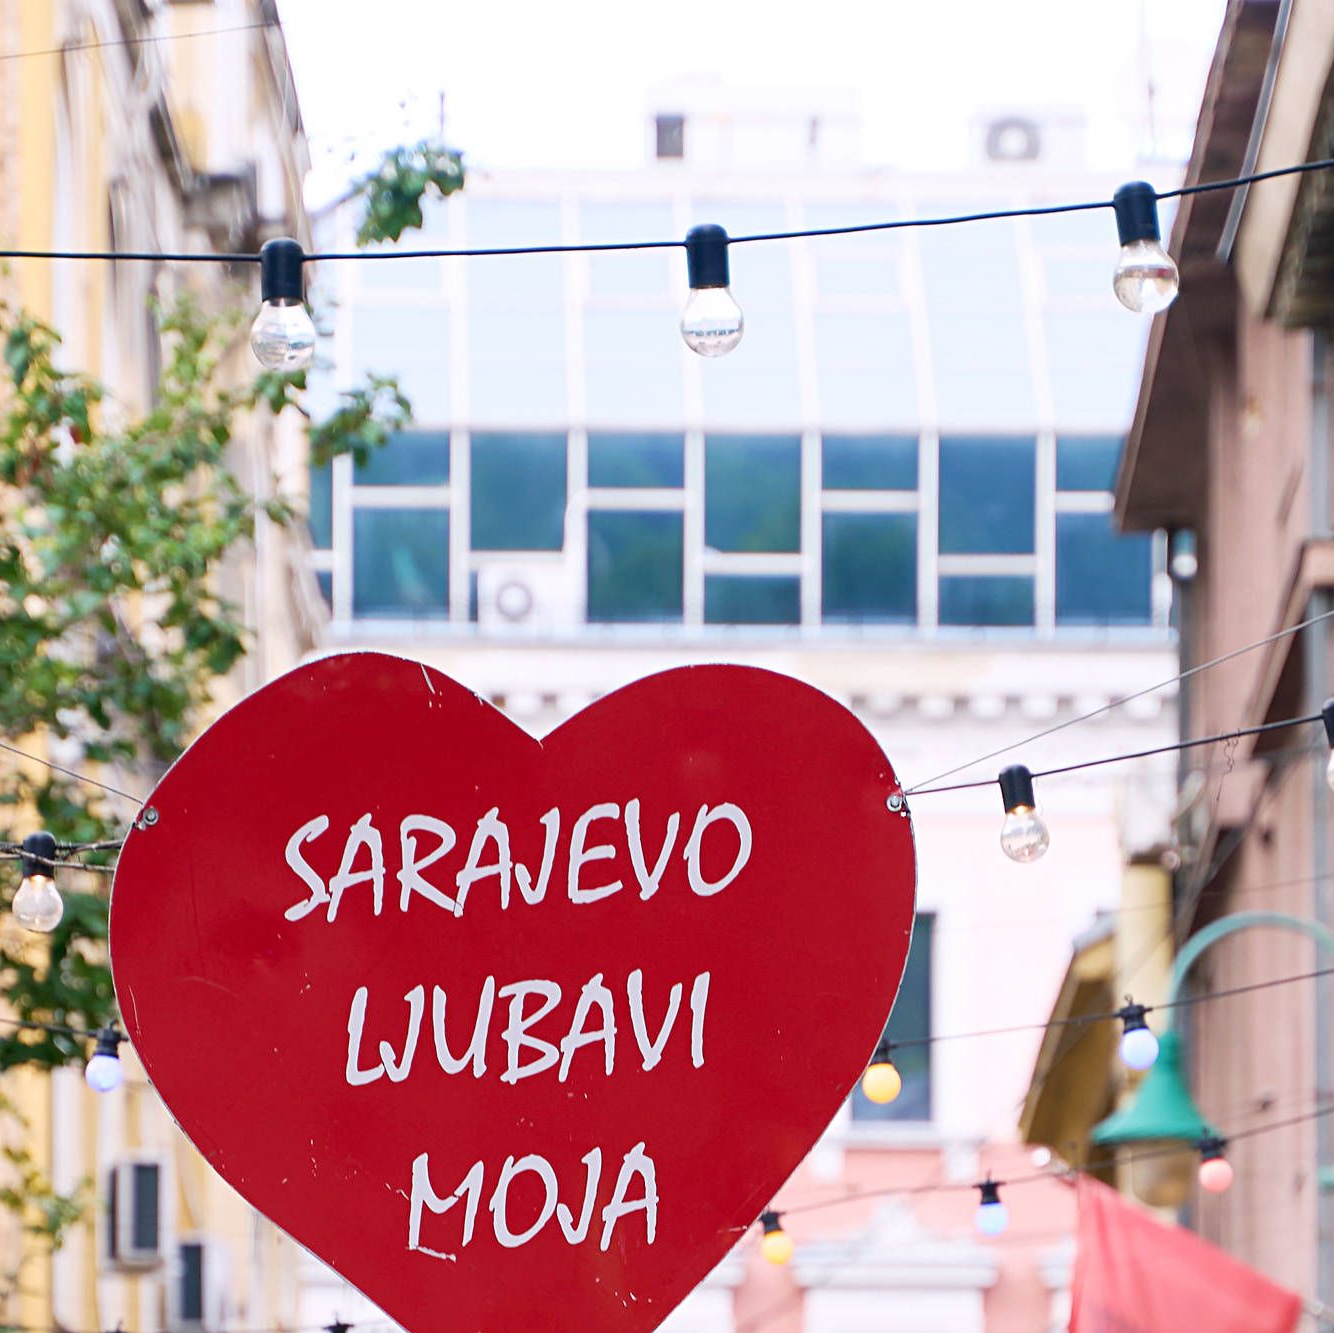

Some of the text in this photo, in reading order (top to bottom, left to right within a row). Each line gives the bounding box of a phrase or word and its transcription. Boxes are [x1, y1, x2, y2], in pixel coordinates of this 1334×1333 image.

[283, 797, 753, 923] SARAJEVO
[344, 968, 711, 1086] LJUBAVI
[407, 1141, 660, 1252] MOJA
